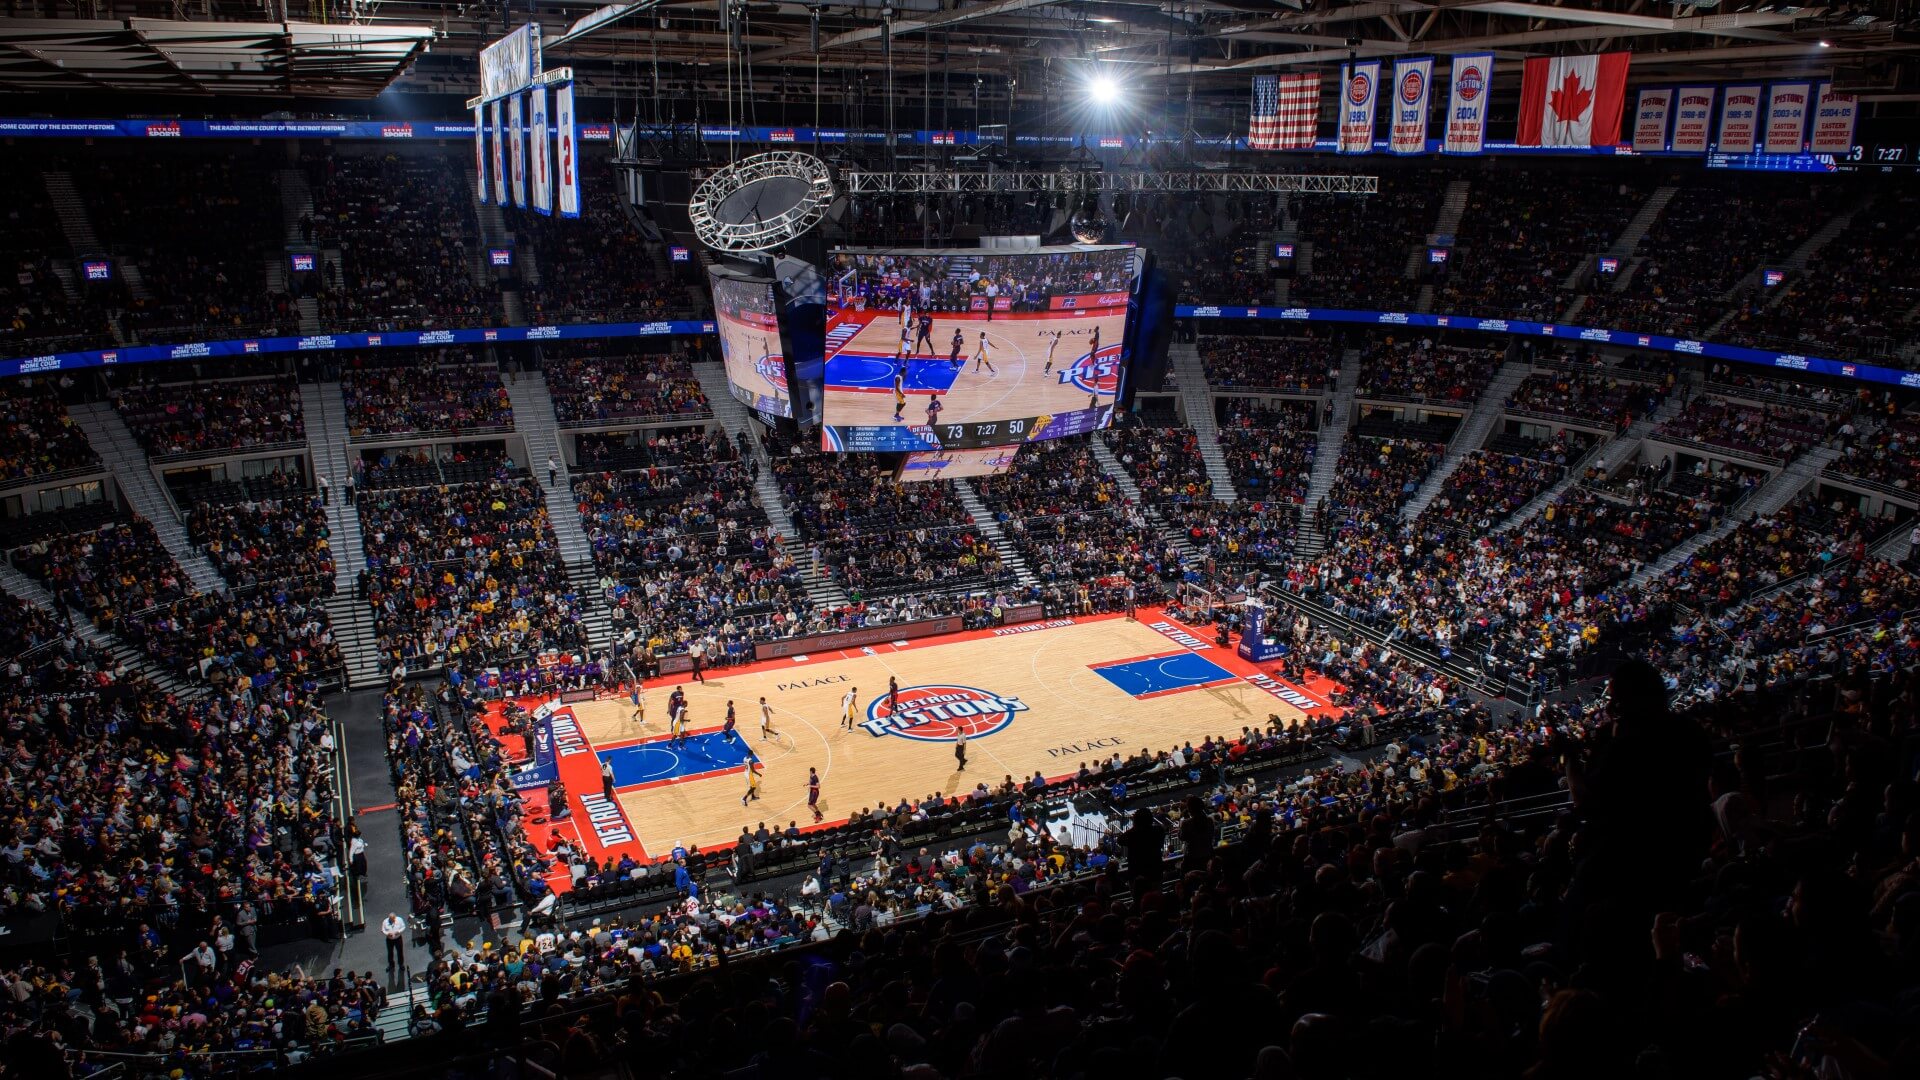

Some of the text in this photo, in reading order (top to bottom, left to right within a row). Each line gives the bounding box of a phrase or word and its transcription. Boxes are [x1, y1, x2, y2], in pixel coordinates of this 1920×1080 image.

[1641, 97, 1666, 107] PISTONS
[1682, 96, 1710, 106] PISTONS
[1728, 96, 1756, 105] PISTONS
[1774, 94, 1804, 104] PISTONS
[1822, 93, 1854, 104] PISTONS
[1456, 108, 1476, 119] 2004
[564, 135, 572, 185] 2
[1878, 148, 1902, 160] 7:27
[948, 426, 963, 439] 73
[977, 424, 997, 436] 7:27
[1009, 420, 1024, 434] 50
[992, 618, 1076, 636] PISTONS.COM
[1148, 621, 1214, 651] DETROIT
[777, 674, 852, 692] PALACE
[1244, 673, 1322, 710] PISTONS
[898, 693, 971, 711] DETROIT
[858, 696, 1030, 738] PISTONS
[551, 714, 590, 758] PISTONS
[1048, 736, 1125, 757] PALACE
[580, 792, 634, 848] DETROIT
